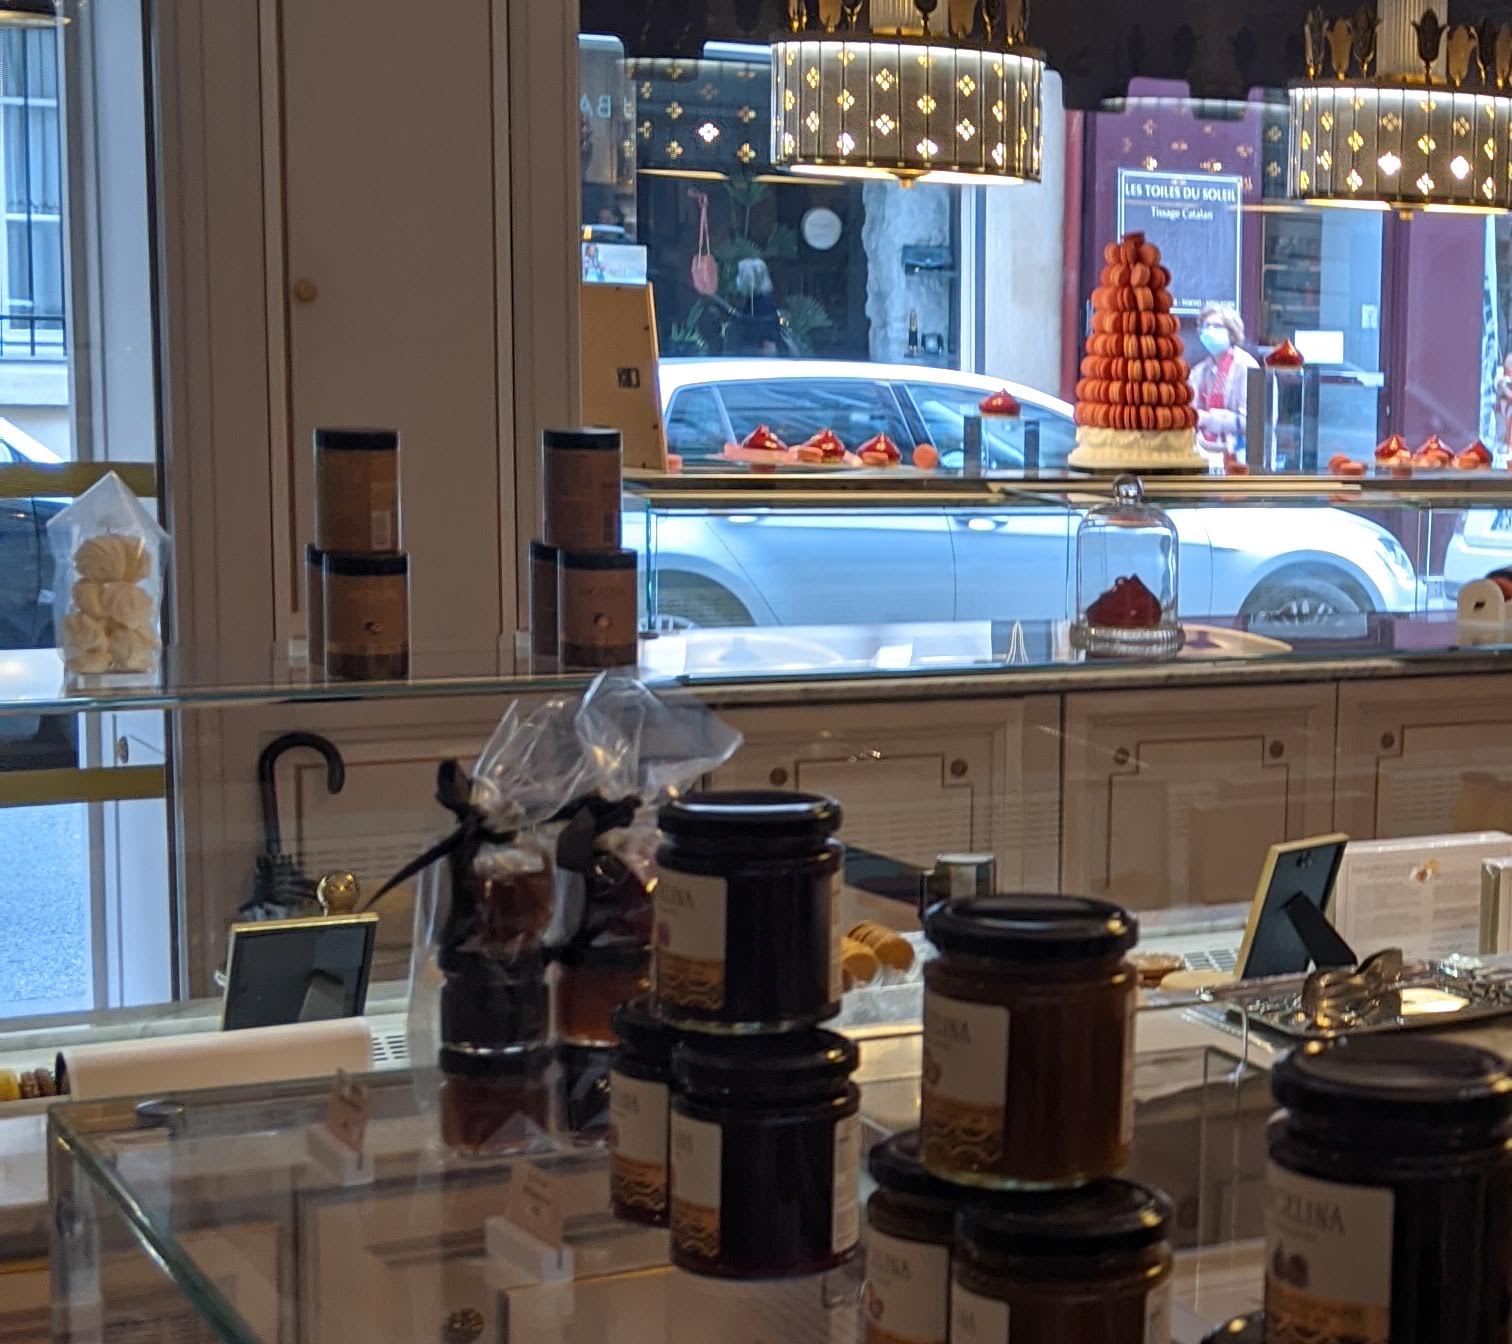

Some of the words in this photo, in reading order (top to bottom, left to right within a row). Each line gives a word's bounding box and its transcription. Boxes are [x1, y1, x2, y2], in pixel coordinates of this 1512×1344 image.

[1125, 183, 1143, 197] LES
[1144, 184, 1181, 200] TOILES
[1183, 187, 1200, 200] DU
[1202, 188, 1237, 202] SOLEIL
[1151, 206, 1181, 221] Tissage
[1182, 207, 1214, 221] Catalan
